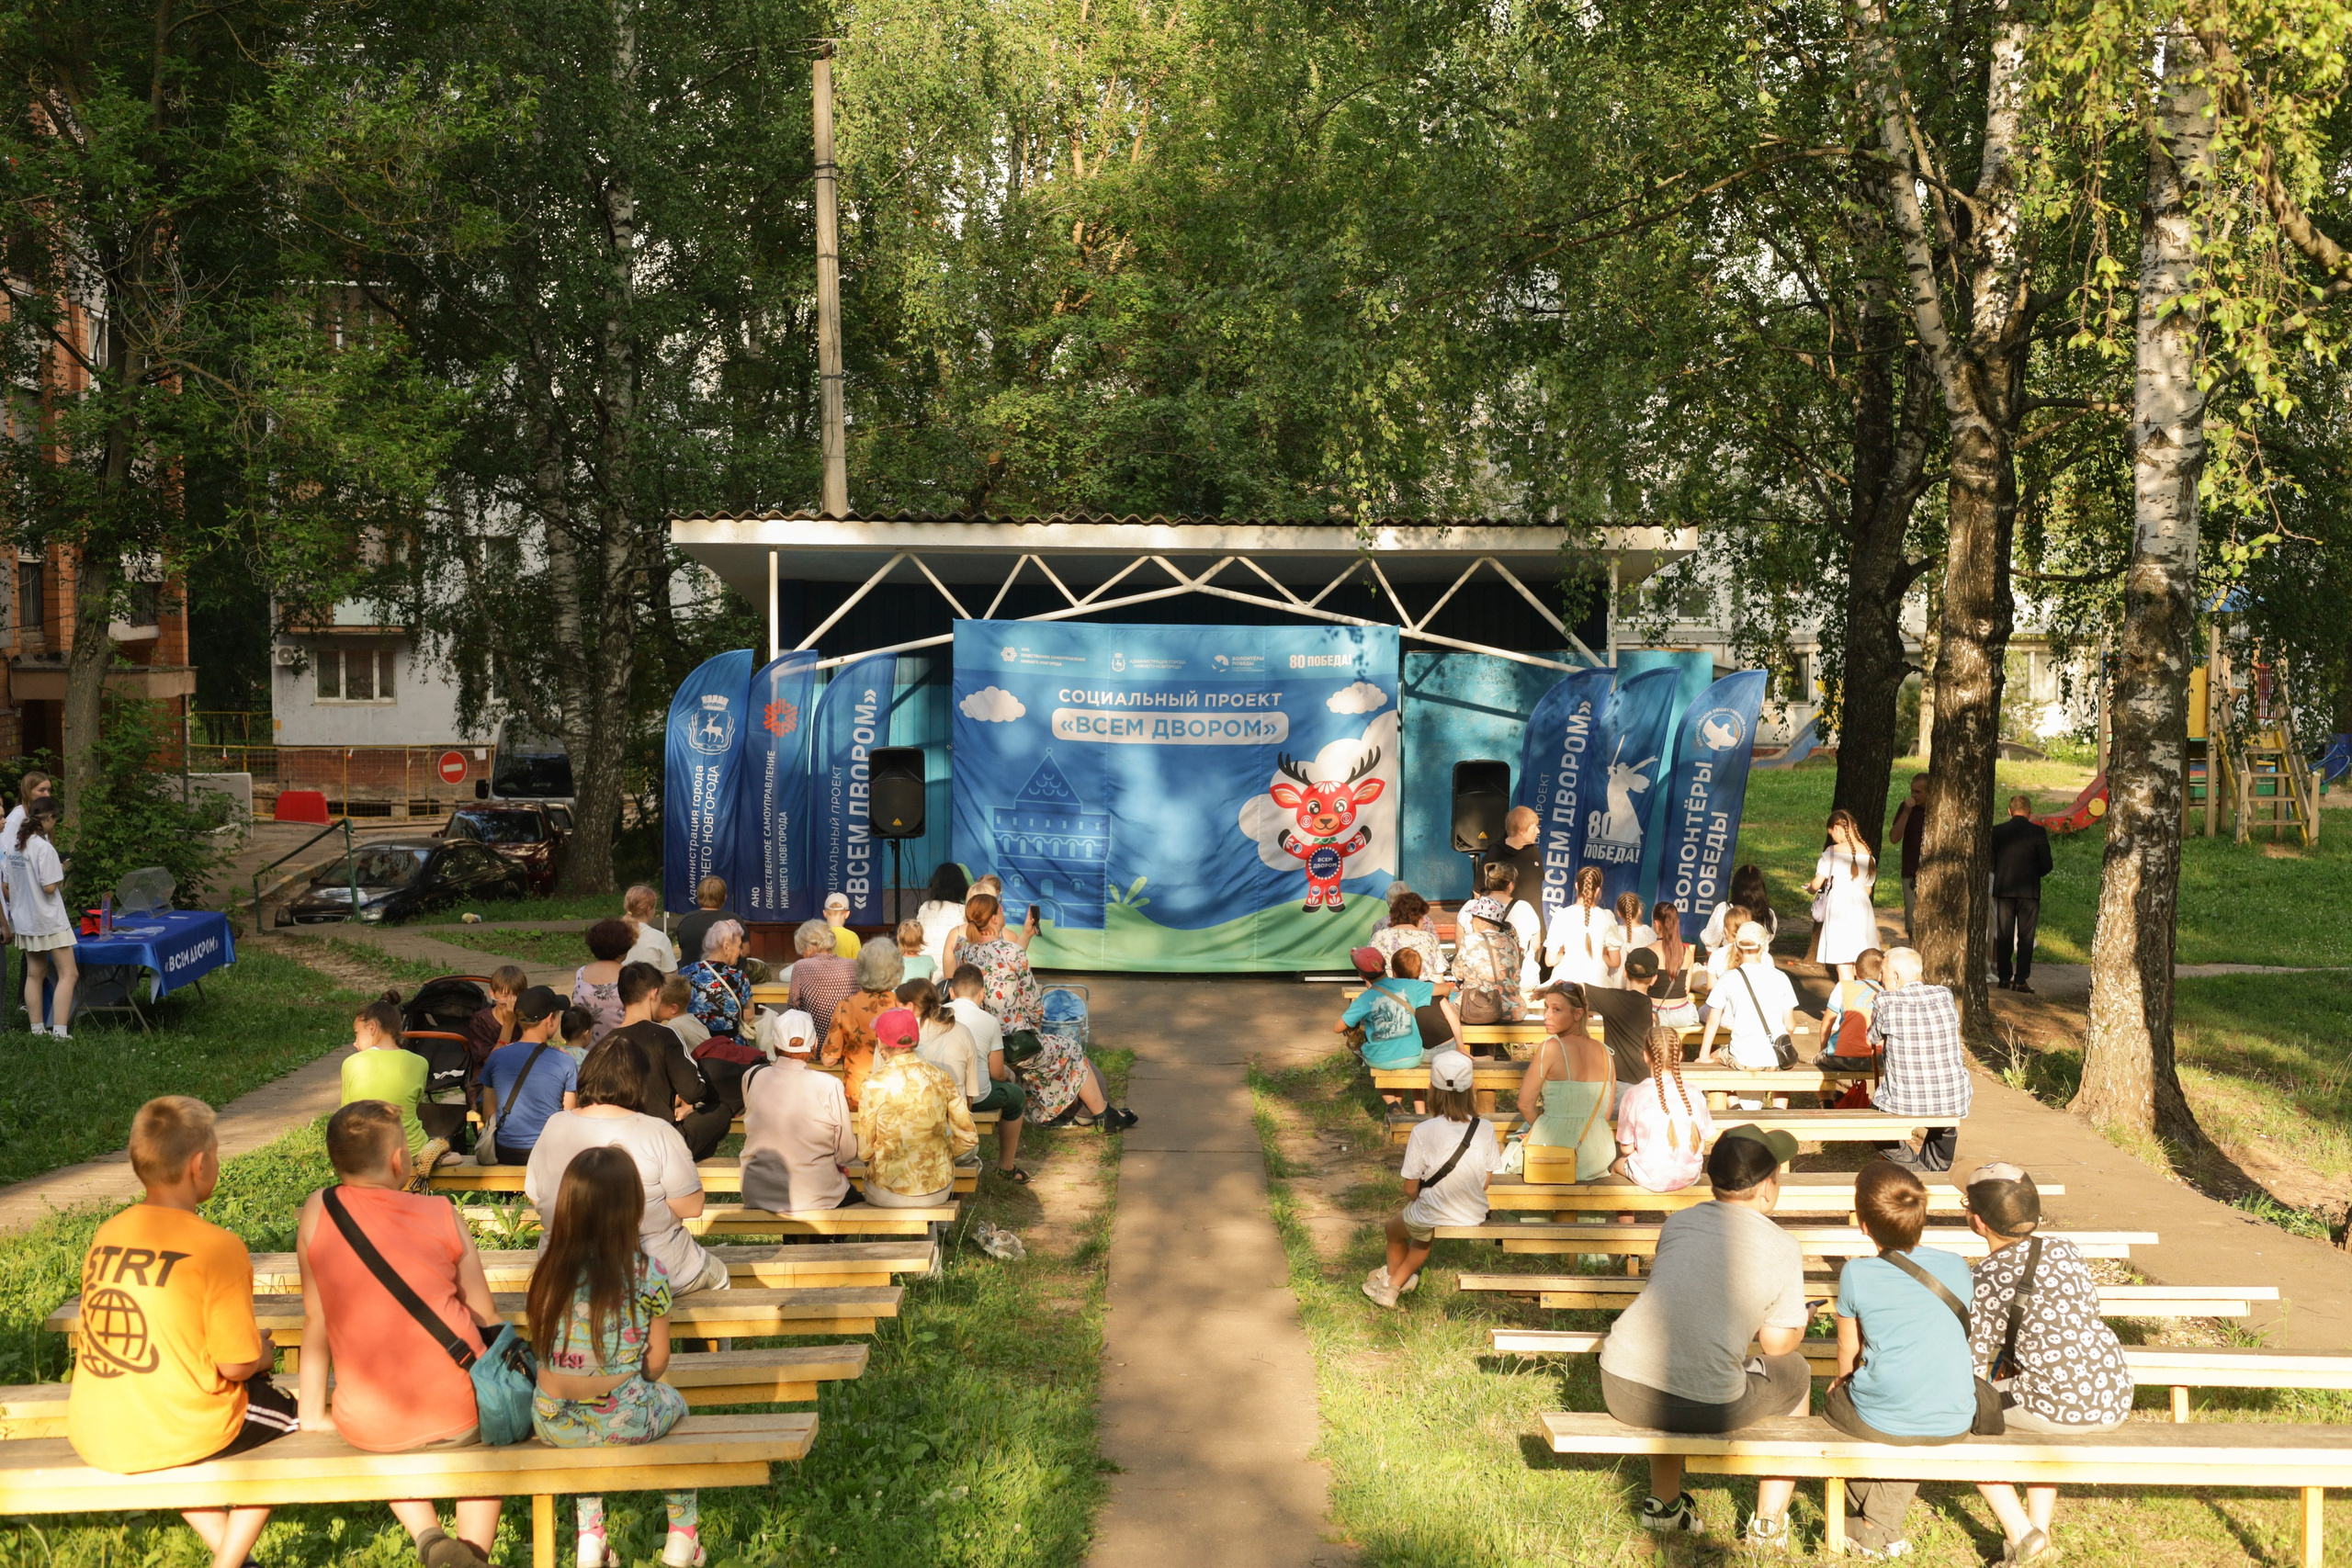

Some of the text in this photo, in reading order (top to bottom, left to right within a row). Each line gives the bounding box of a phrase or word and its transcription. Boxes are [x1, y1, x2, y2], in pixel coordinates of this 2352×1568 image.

[1058, 688, 1283, 707] СОЦИАЛЬНЫЙ ПРОЕКТ
[1289, 654, 1352, 669] 80 ПОБЕДА!
[1060, 716, 1278, 739] «ВСЕМ ДВОРОМ»
[1552, 700, 1591, 827] ДВОРОМ»
[702, 764, 719, 843] НОВГОРОДА
[831, 764, 842, 815] ПРОЕКТ
[846, 688, 877, 909] «ВСЕМ ДВОРОМ»
[1588, 810, 1613, 840] 80
[688, 765, 704, 905] Администрация города
[763, 750, 776, 909] ОБЩЕСТВЕННОЕ САМОУПРАВЛЕНИЕ
[778, 811, 789, 908] НИЖНЕГО НОВГОРОДА
[1584, 843, 1640, 863] ПОБЕДА!
[1674, 761, 1713, 913] ВОЛОНТЁРЫ
[1694, 811, 1728, 915] ПОБЕДЫ
[751, 886, 760, 908] АНО
